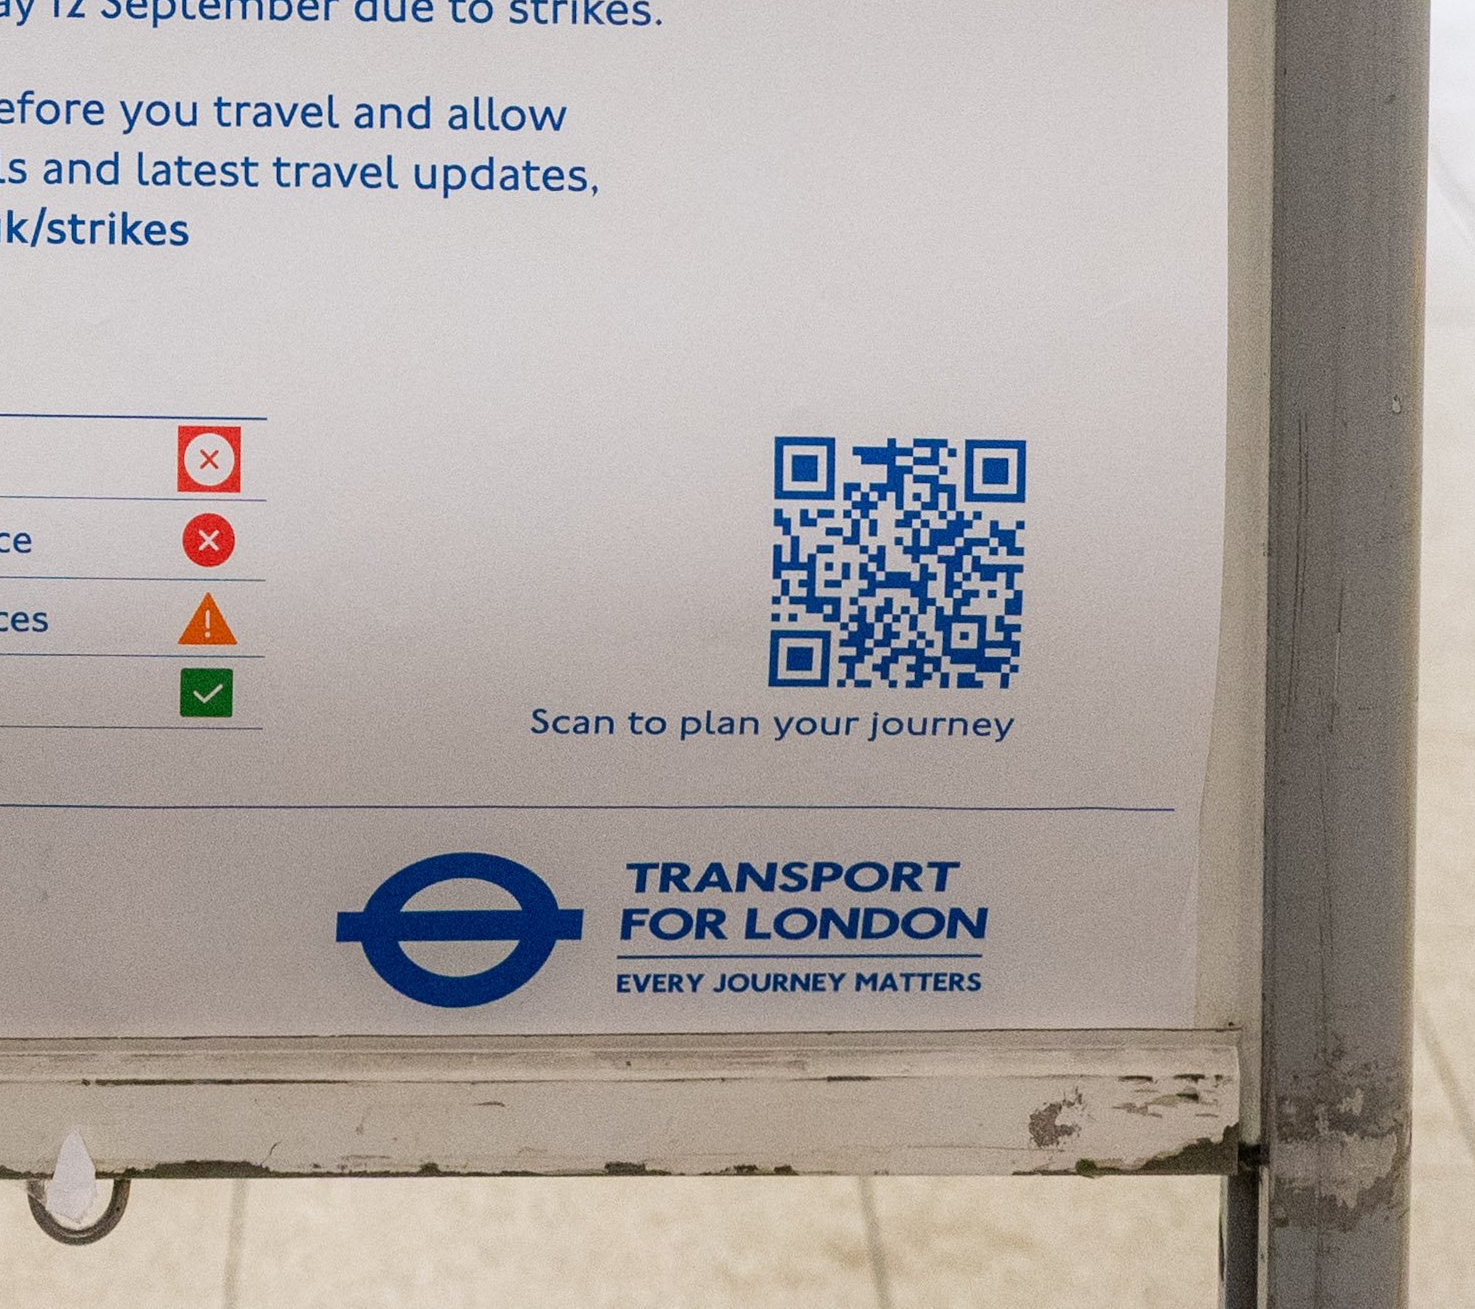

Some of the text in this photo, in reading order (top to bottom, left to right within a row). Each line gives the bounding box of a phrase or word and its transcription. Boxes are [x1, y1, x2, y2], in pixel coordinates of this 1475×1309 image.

[532, 709, 1013, 741] Scan to plan your journey
[627, 861, 959, 893] TRANSPORT
[621, 907, 988, 941] FOR LONDON
[617, 972, 982, 993] EVERY JOURNEY MATTERS
